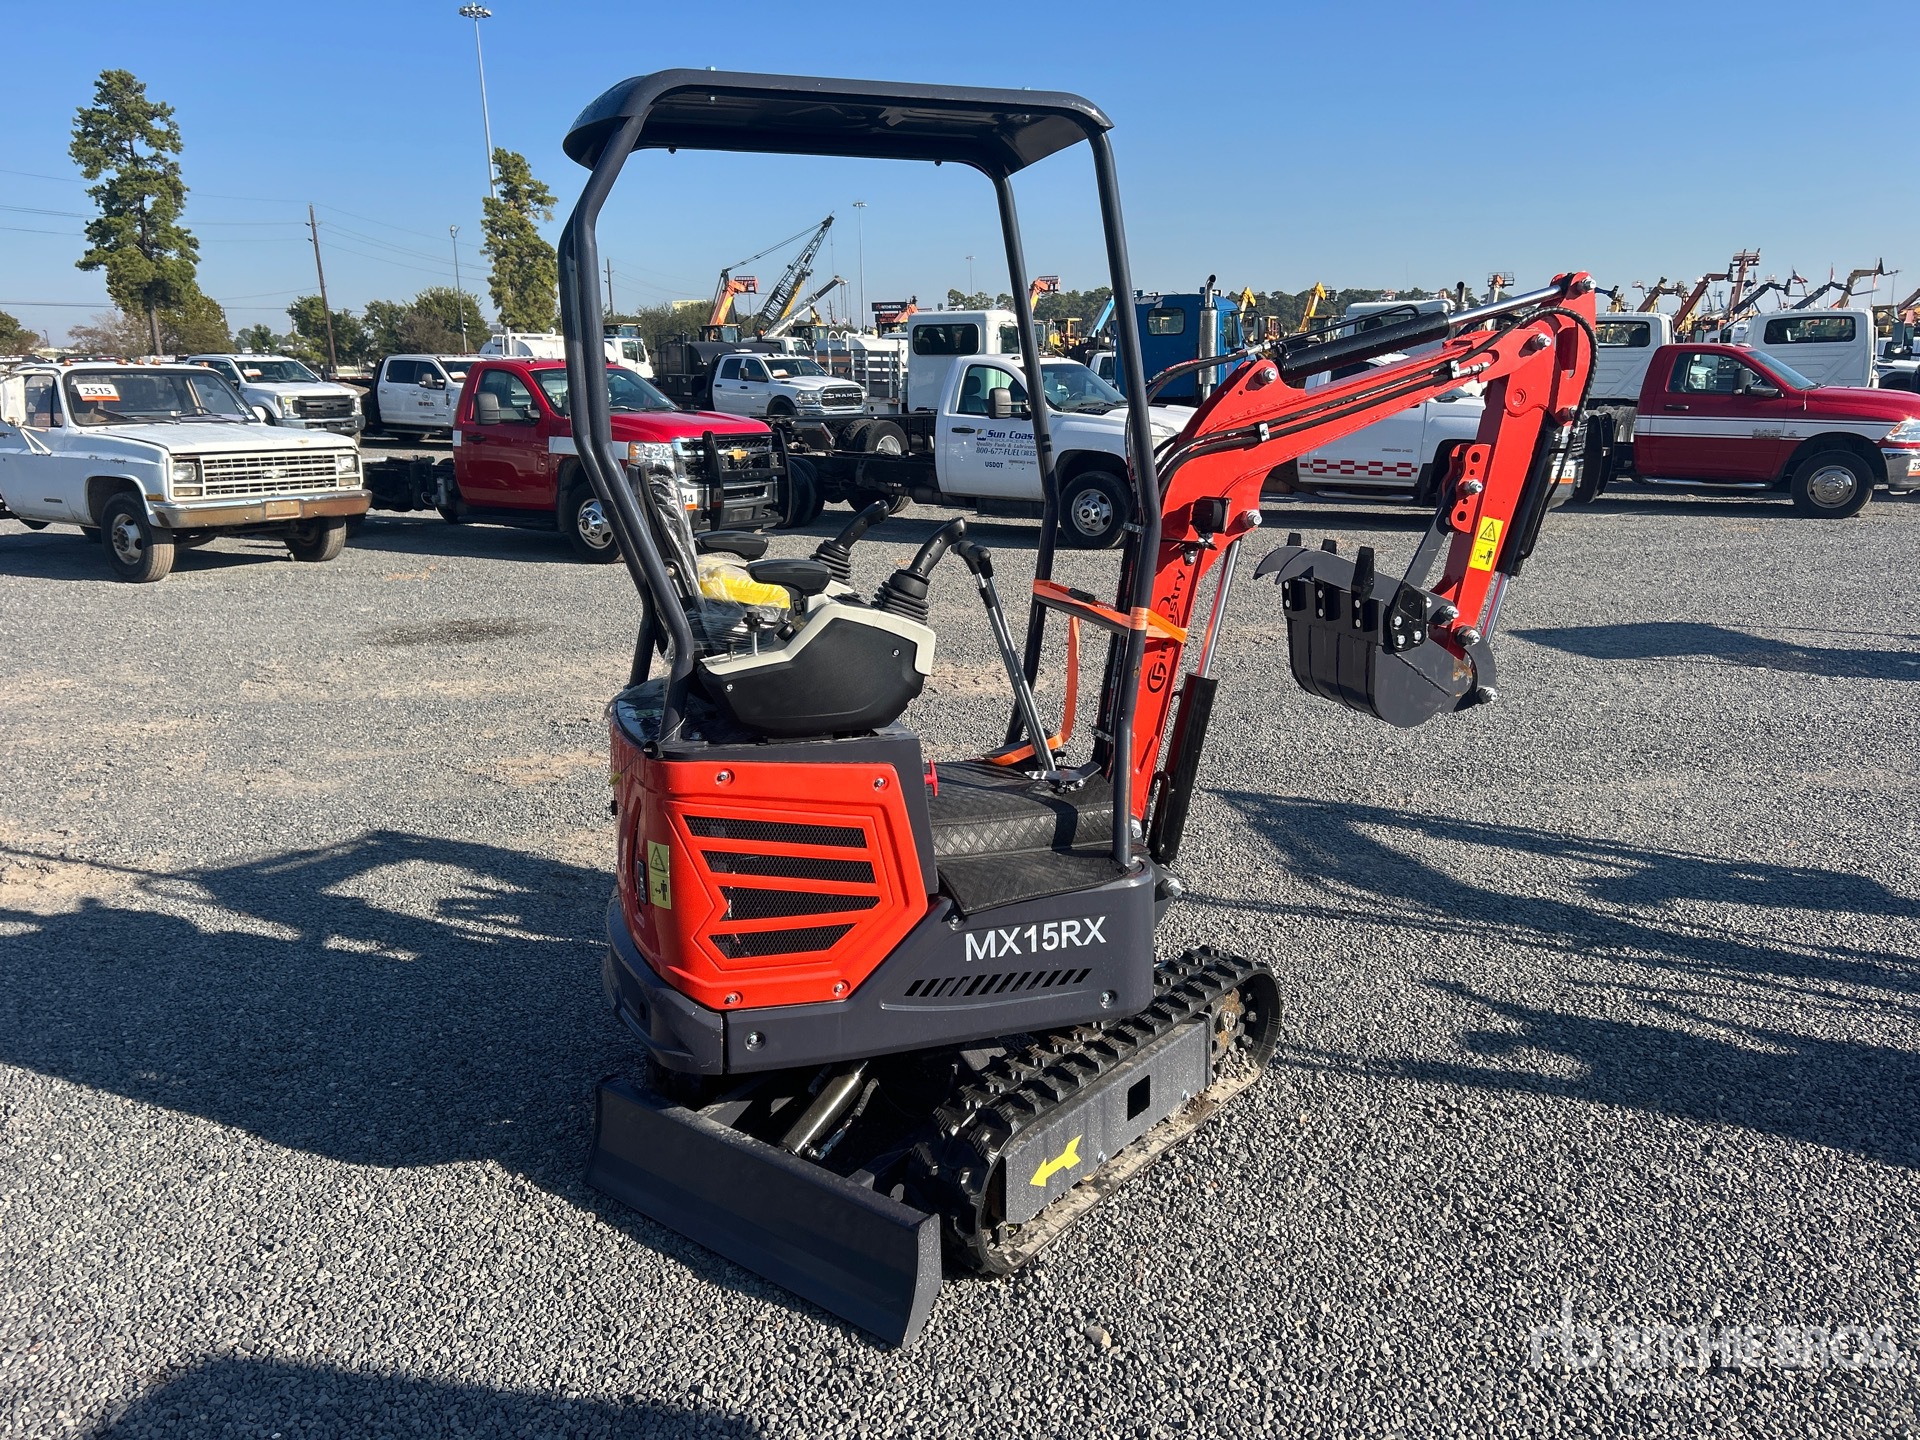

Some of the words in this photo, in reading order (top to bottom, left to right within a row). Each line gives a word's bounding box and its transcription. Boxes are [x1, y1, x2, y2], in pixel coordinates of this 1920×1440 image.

[83, 387, 112, 395] 2515
[987, 429, 1006, 438] Sun
[965, 916, 1107, 962] MX15RX
